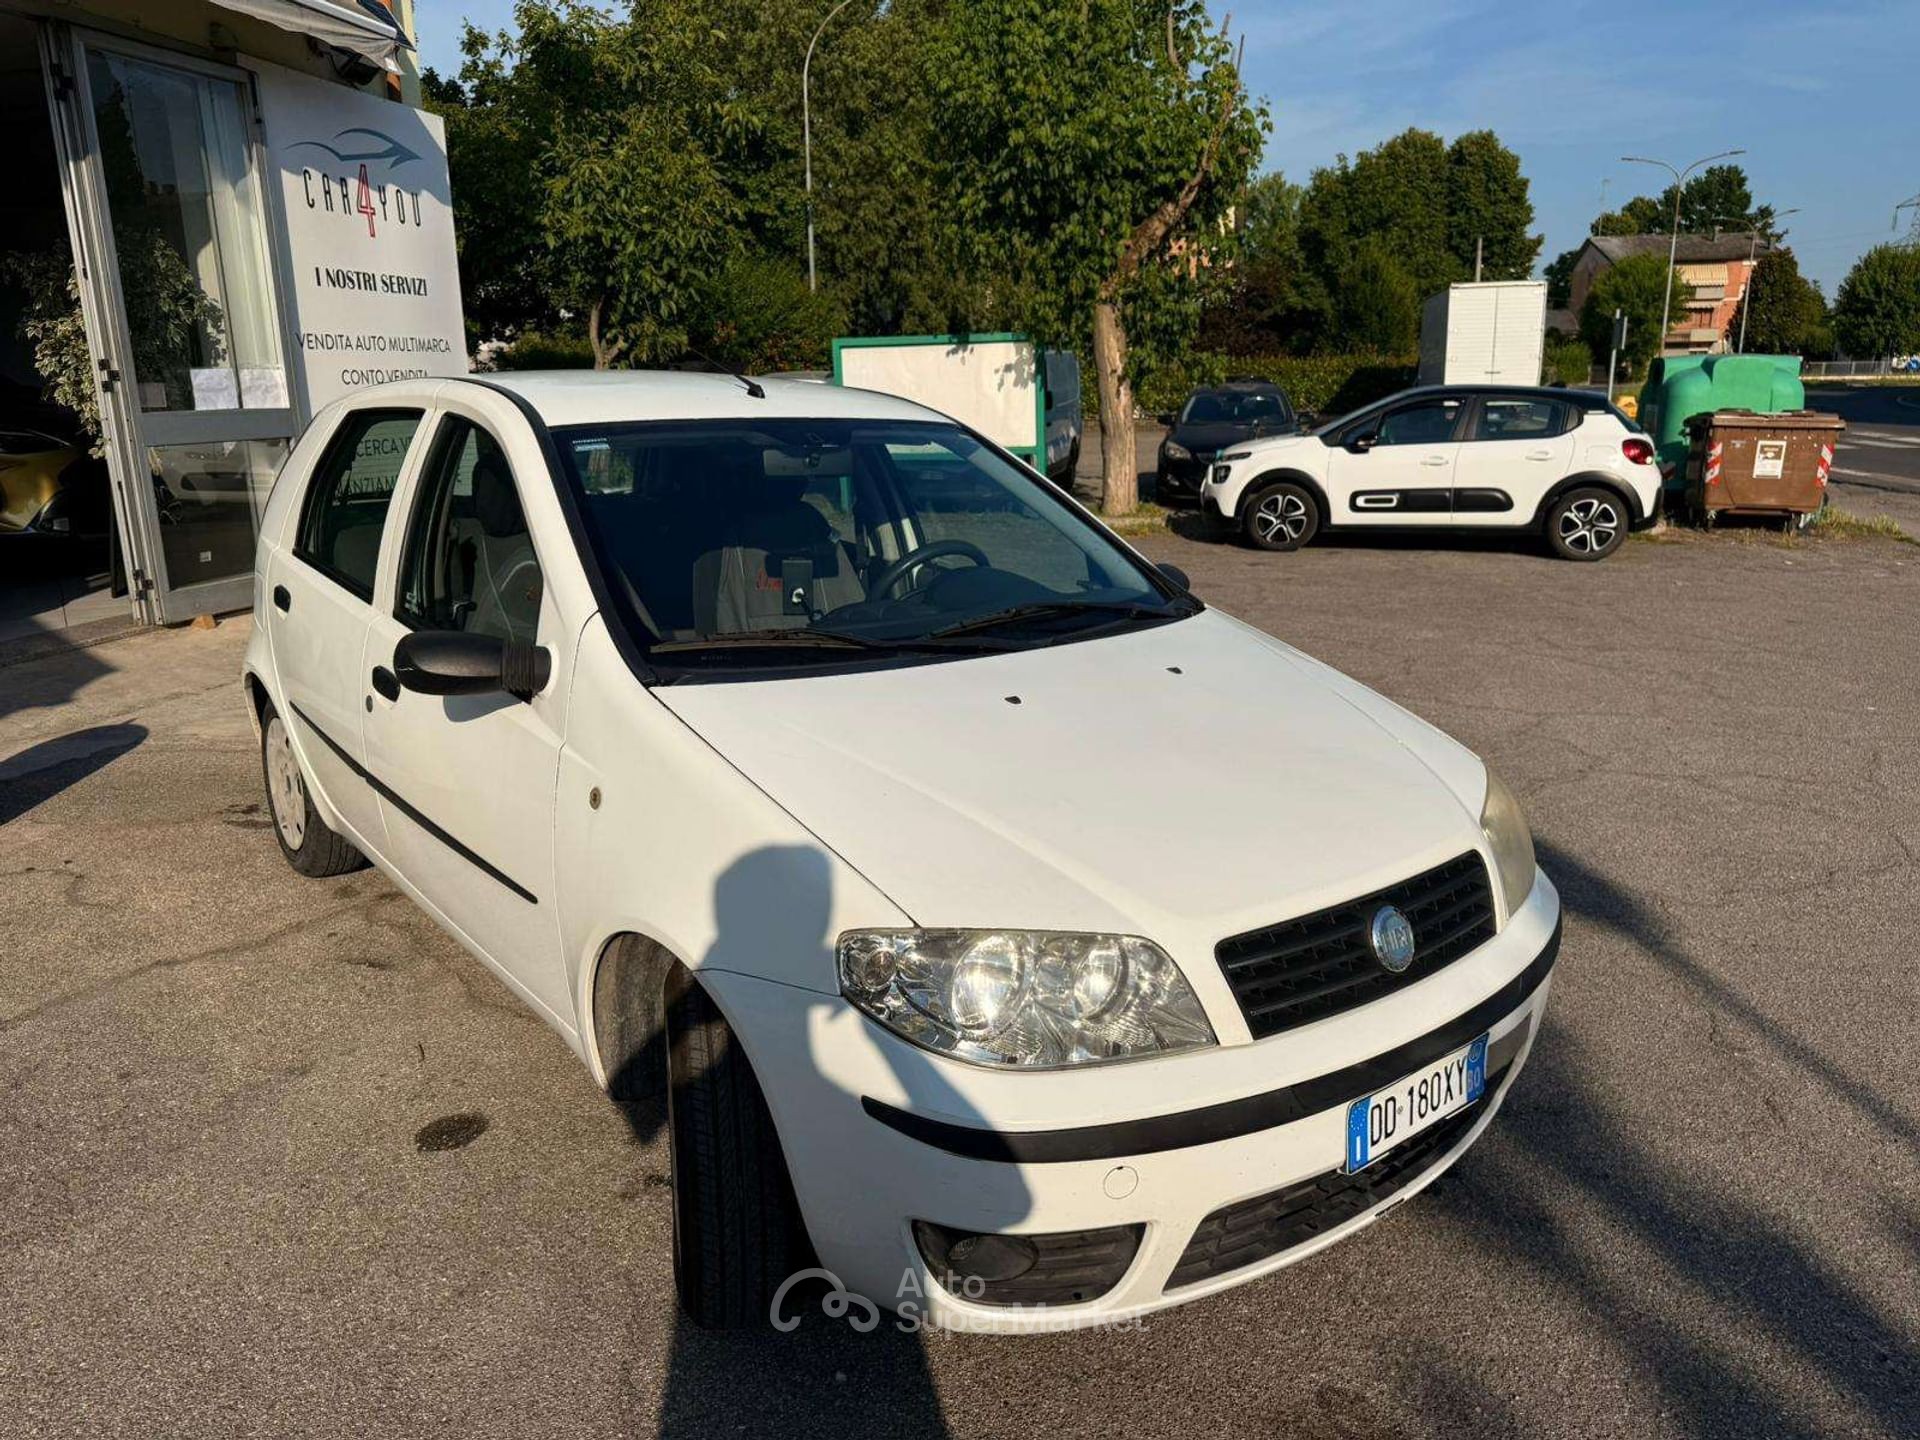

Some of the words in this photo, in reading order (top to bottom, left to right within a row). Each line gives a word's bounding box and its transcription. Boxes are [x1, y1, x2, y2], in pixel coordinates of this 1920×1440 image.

[315, 266, 322, 287] I
[326, 268, 377, 292] NOSTRI
[381, 275, 428, 297] SERVIZI
[295, 331, 354, 351] VENDITA
[356, 334, 387, 352] AUTO
[389, 336, 452, 354] MULTIMARCA
[341, 369, 384, 386] CONTO
